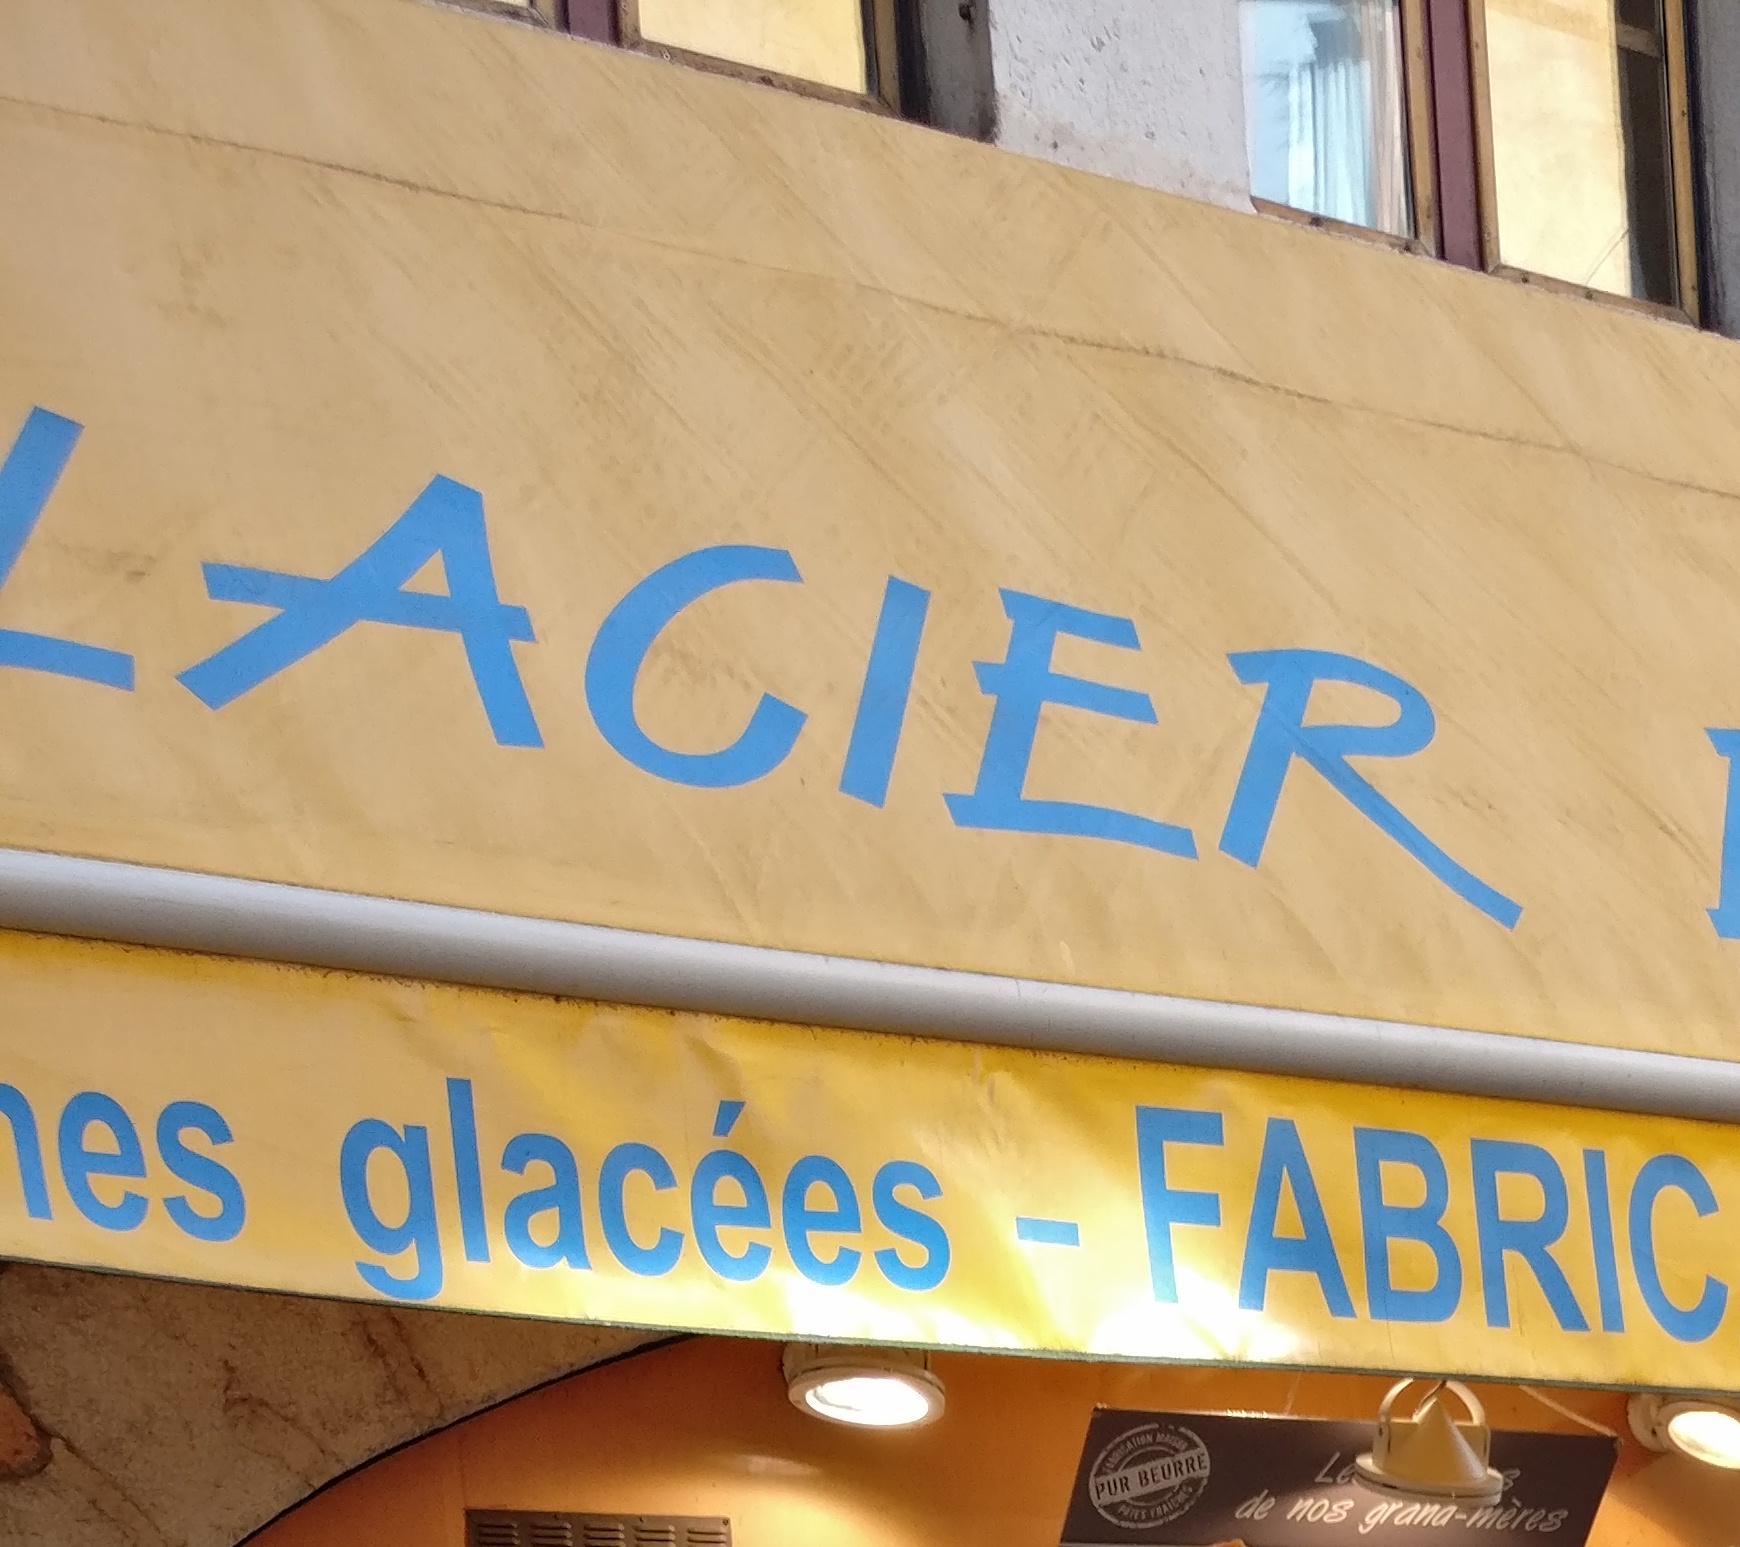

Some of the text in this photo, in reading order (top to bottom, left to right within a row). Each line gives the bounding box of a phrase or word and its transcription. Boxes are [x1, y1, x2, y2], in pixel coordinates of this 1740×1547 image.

[339, 1075, 952, 1301] glacées
[1095, 1451, 1209, 1500] PUR BEURRE
[1235, 1489, 1271, 1522] de
[1287, 1497, 1350, 1524] nos
